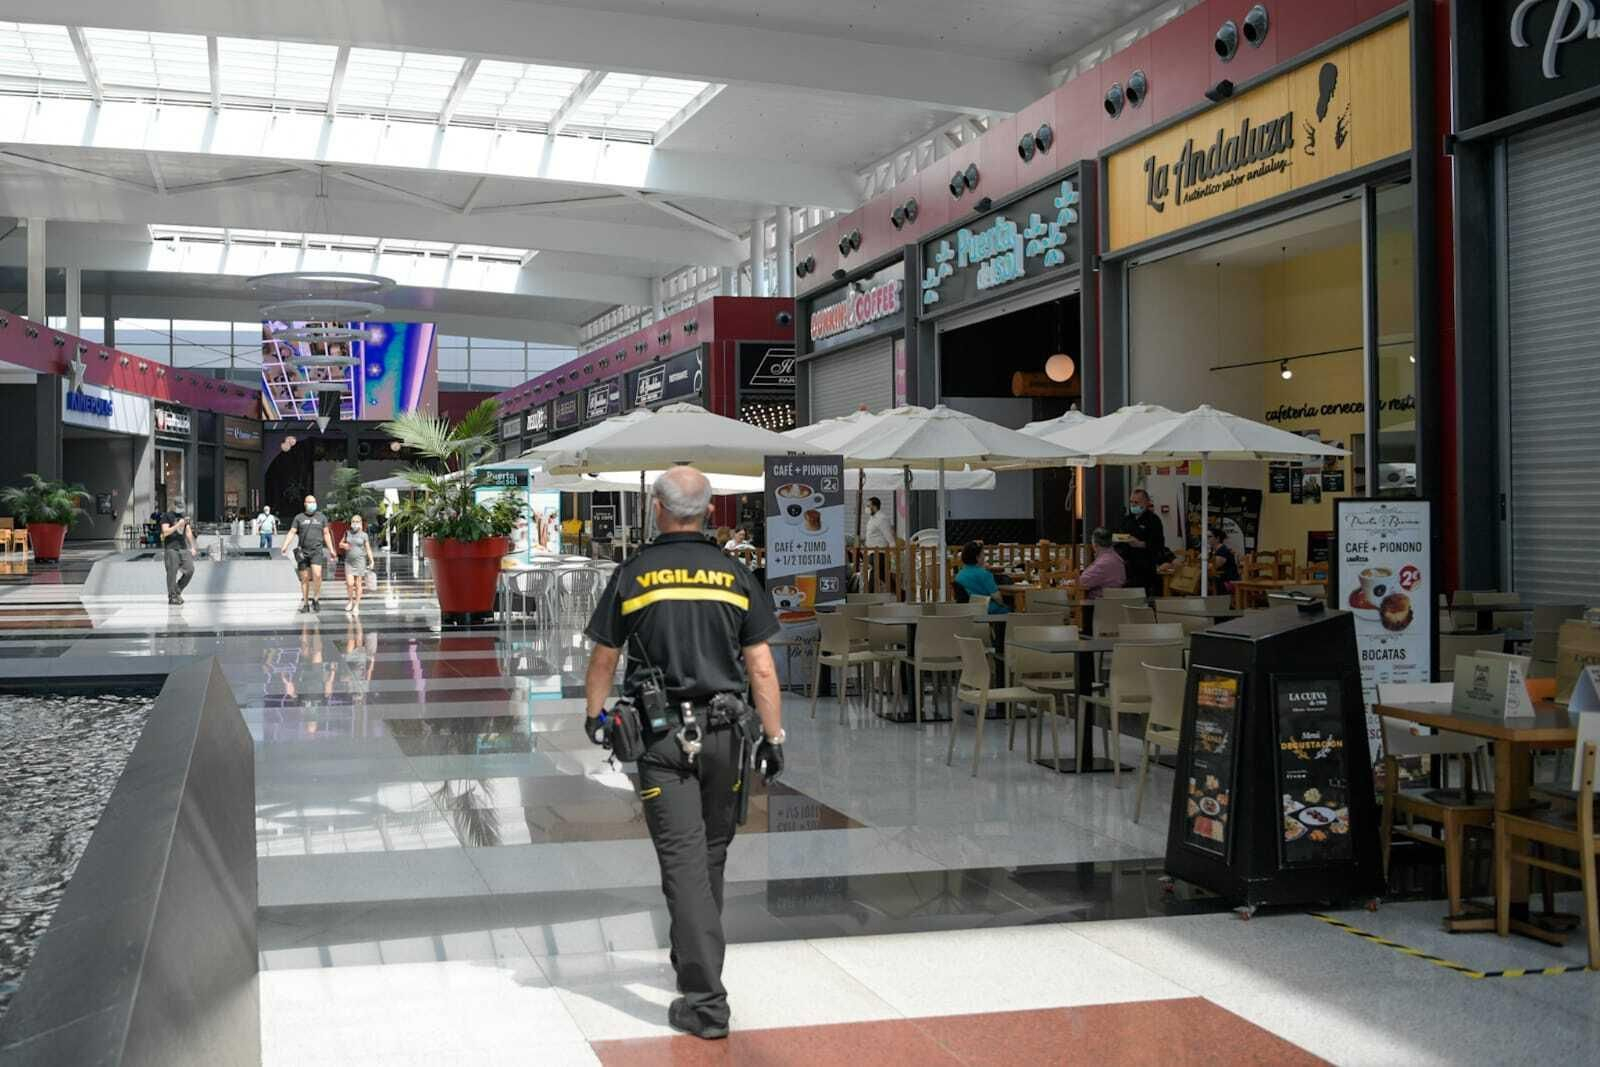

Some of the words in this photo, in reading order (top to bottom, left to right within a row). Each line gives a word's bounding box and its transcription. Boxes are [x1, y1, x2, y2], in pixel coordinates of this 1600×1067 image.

[1144, 155, 1169, 213] La
[1173, 111, 1294, 206] Andaluza
[1221, 173, 1245, 192] sabor
[957, 216, 1017, 268] Puerta
[855, 279, 902, 327] COFFEE
[773, 462, 793, 476] CAFÉ
[802, 465, 838, 476] PIONONO
[774, 540, 793, 553] CAFÉ
[803, 541, 826, 553] ZUMO
[1345, 540, 1369, 553] CAFÉ
[1380, 541, 1422, 553] PIONONO
[783, 554, 797, 566] 1/2
[799, 554, 832, 566] TOSTADA
[636, 569, 735, 588] VIGILANT
[1362, 649, 1406, 661] BOCATAS
[1289, 692, 1300, 701] LA
[1301, 692, 1327, 701] CUEVA
